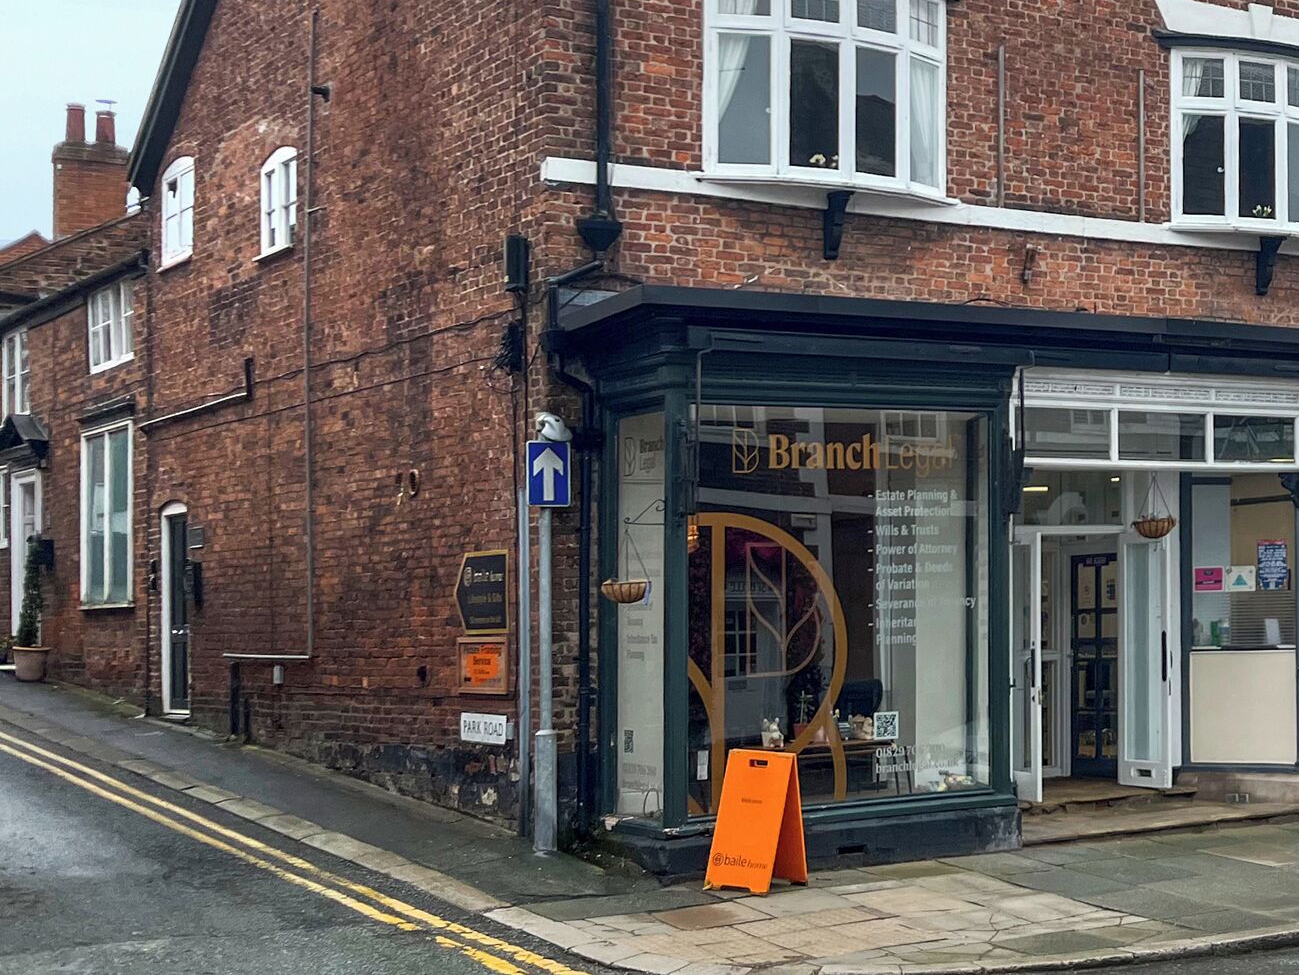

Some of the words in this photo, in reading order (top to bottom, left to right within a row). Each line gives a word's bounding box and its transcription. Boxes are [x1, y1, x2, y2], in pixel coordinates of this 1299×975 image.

[875, 490, 905, 501] Estate
[908, 489, 948, 502] Planning
[950, 489, 958, 500] &
[875, 506, 902, 517] Asset
[904, 506, 952, 516] Protection
[875, 525, 899, 536] Wills
[901, 525, 909, 535] &
[911, 525, 939, 536] Trusts
[876, 544, 905, 555] Power
[907, 542, 917, 554] of
[919, 543, 957, 556] Attorney
[876, 563, 913, 574] Probate
[463, 719, 481, 734] PARK
[483, 720, 504, 737] ROAD
[875, 746, 904, 758] 01829
[724, 855, 747, 867] baile
